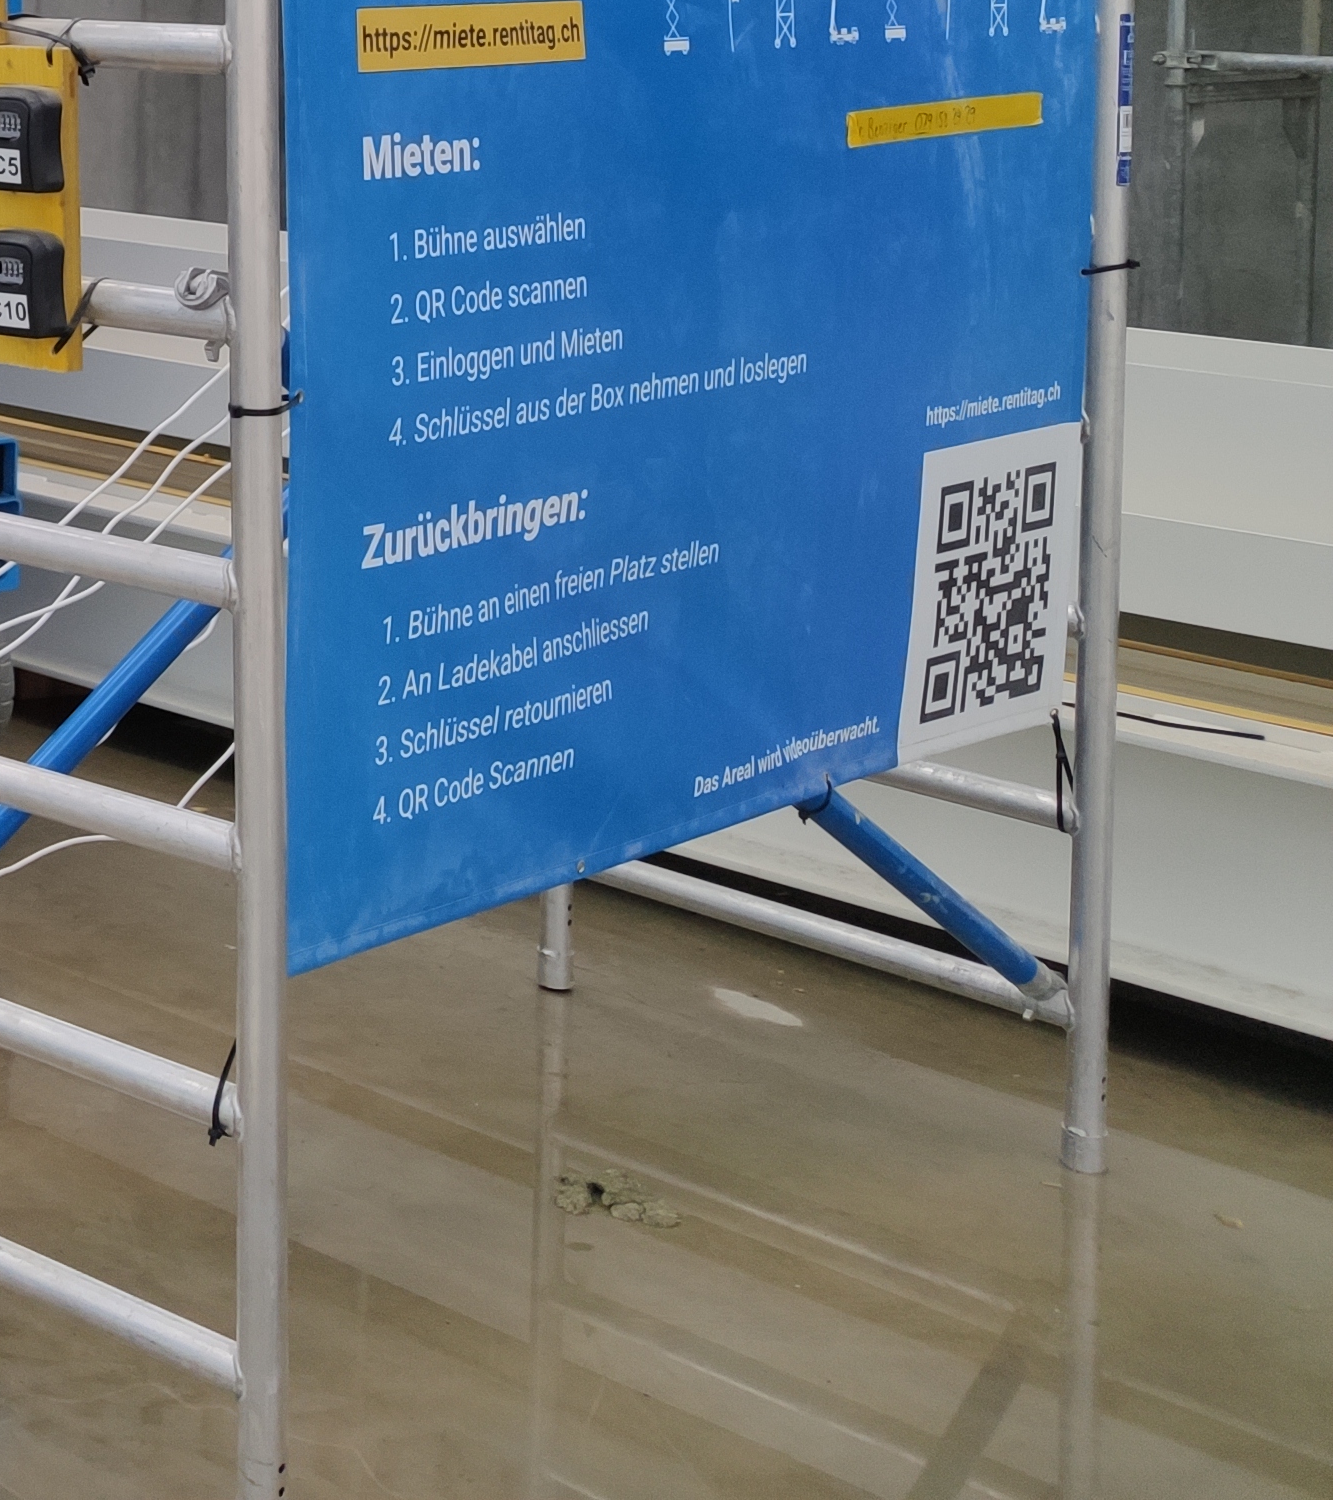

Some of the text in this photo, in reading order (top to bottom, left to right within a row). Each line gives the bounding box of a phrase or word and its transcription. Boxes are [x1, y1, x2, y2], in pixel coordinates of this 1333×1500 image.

[362, 16, 581, 59] https://miete.rentitag.ch
[362, 132, 481, 181] Mieten:
[389, 212, 586, 262] 1. Bühne auswählen
[390, 275, 588, 325] 2. QR Code scannen
[391, 327, 623, 386] 3. Einloggen und Mieten
[388, 352, 808, 447] 4. Schlüssel aus der Box nehmen und loslegen
[926, 381, 1061, 429] https://miete.rentitag.ch
[361, 489, 589, 569] Zurückbringen:
[383, 540, 720, 645] 1. Bühne an einen freien Platz stellen
[378, 610, 649, 706] 2. An Ladekabel anschliessen
[375, 679, 613, 766] 3. Schlüssel retournieren
[694, 716, 880, 798] Das Areal wird videoüberwacht.
[373, 748, 575, 824] 4. QR Code Scannen
